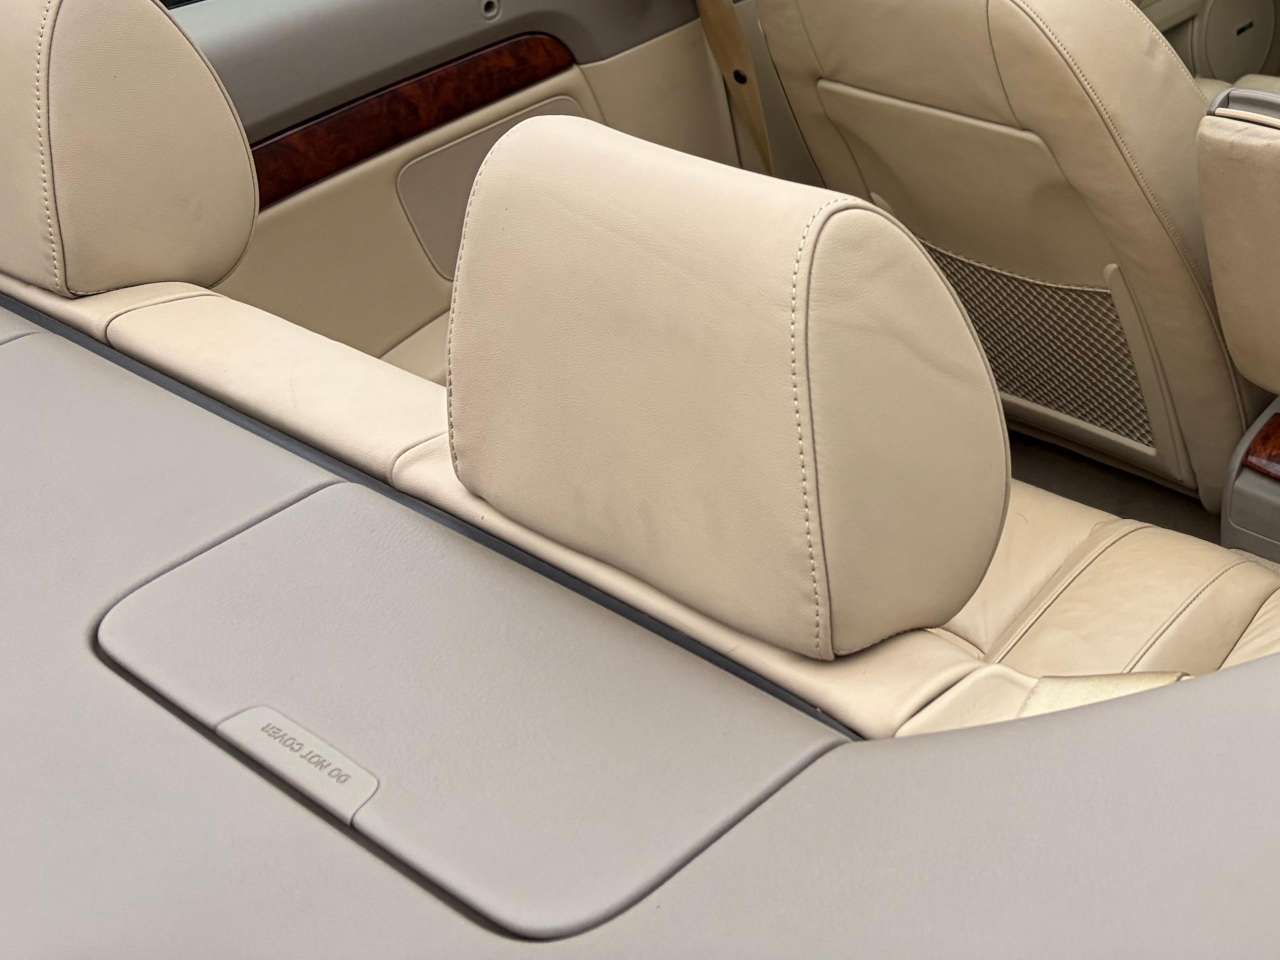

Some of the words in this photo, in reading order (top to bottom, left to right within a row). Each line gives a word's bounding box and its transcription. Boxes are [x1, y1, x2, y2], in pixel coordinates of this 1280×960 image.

[260, 722, 304, 753] COVER
[299, 750, 332, 771] NOT
[327, 768, 352, 784] DO
